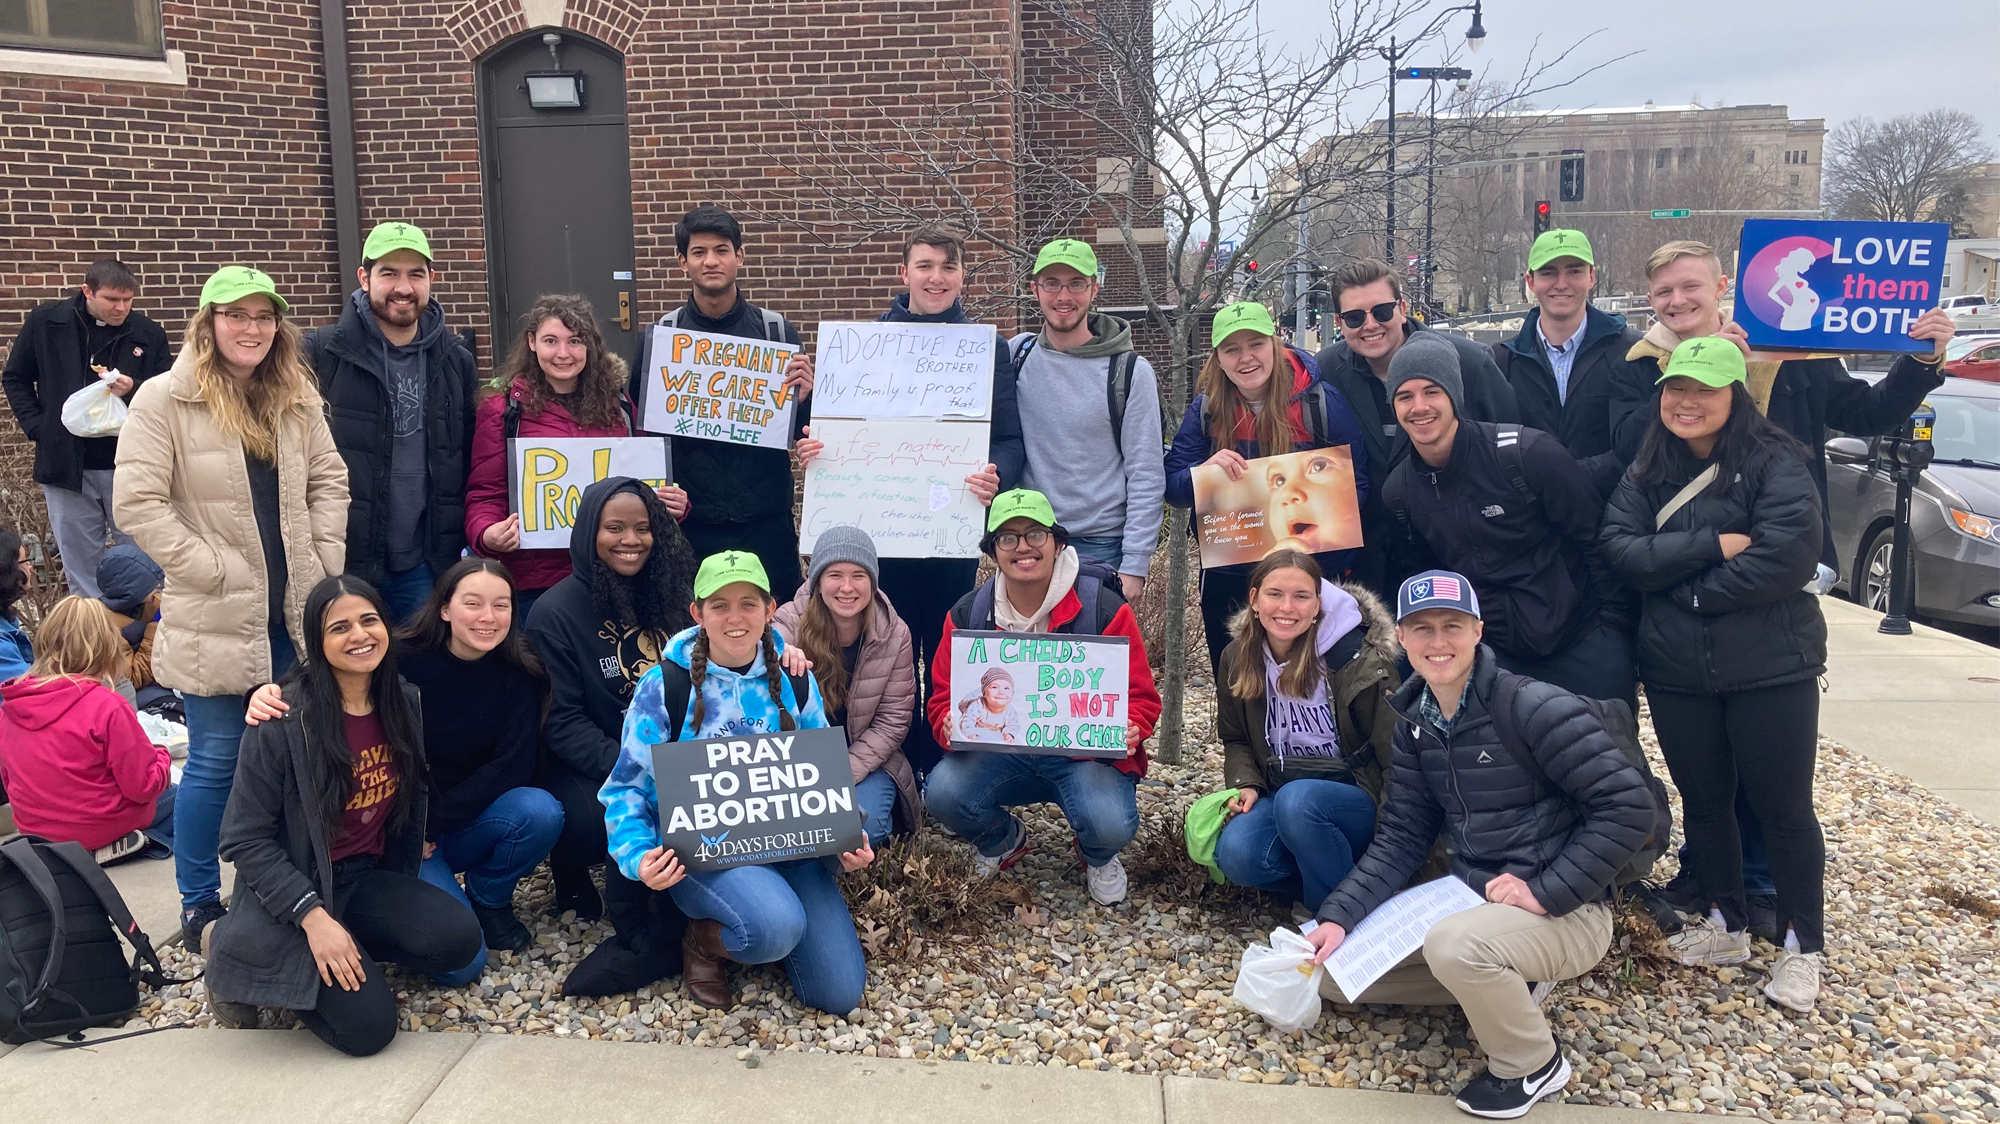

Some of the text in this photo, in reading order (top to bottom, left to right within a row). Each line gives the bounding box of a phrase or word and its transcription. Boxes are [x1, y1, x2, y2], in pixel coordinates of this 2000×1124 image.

[1831, 237, 1932, 266] LOVE
[1843, 273, 1929, 300] them
[1823, 306, 1926, 335] BOTH
[823, 327, 987, 364] ADOPTIVE BIG
[915, 357, 978, 374] BROTHER!
[661, 366, 768, 405] WE CARE
[816, 373, 847, 404] My
[854, 372, 900, 403] family
[925, 382, 976, 406] proof
[666, 393, 774, 428] OFFER HELP
[897, 438, 970, 456] matters!
[814, 468, 863, 487] Beauty
[874, 473, 918, 483] comes
[813, 487, 923, 503] broken situations
[880, 510, 934, 523] cherishes
[950, 512, 968, 524] the
[1203, 509, 1264, 525] Before I formed
[1204, 528, 1217, 537] you
[1230, 522, 1241, 531] the
[1244, 519, 1264, 529] womb
[871, 528, 935, 541] vulnerable!
[1206, 534, 1248, 545] I knew you
[599, 655, 619, 670] FOR
[967, 637, 987, 664] A
[602, 666, 622, 679] THOSE
[1038, 664, 1105, 692] BODY
[1025, 692, 1120, 719] IS NOT
[1288, 701, 1335, 734] ANYO
[713, 720, 736, 738] AND
[740, 717, 764, 728] FOR
[1025, 722, 1072, 747] OUR
[706, 736, 796, 768] PRAY
[360, 765, 388, 790] THE
[690, 762, 820, 799] TO END
[666, 786, 853, 834] ABORTION
[764, 831, 797, 851] FOR
[716, 845, 816, 865] WWW.40DAYSFORLIFE.COM
